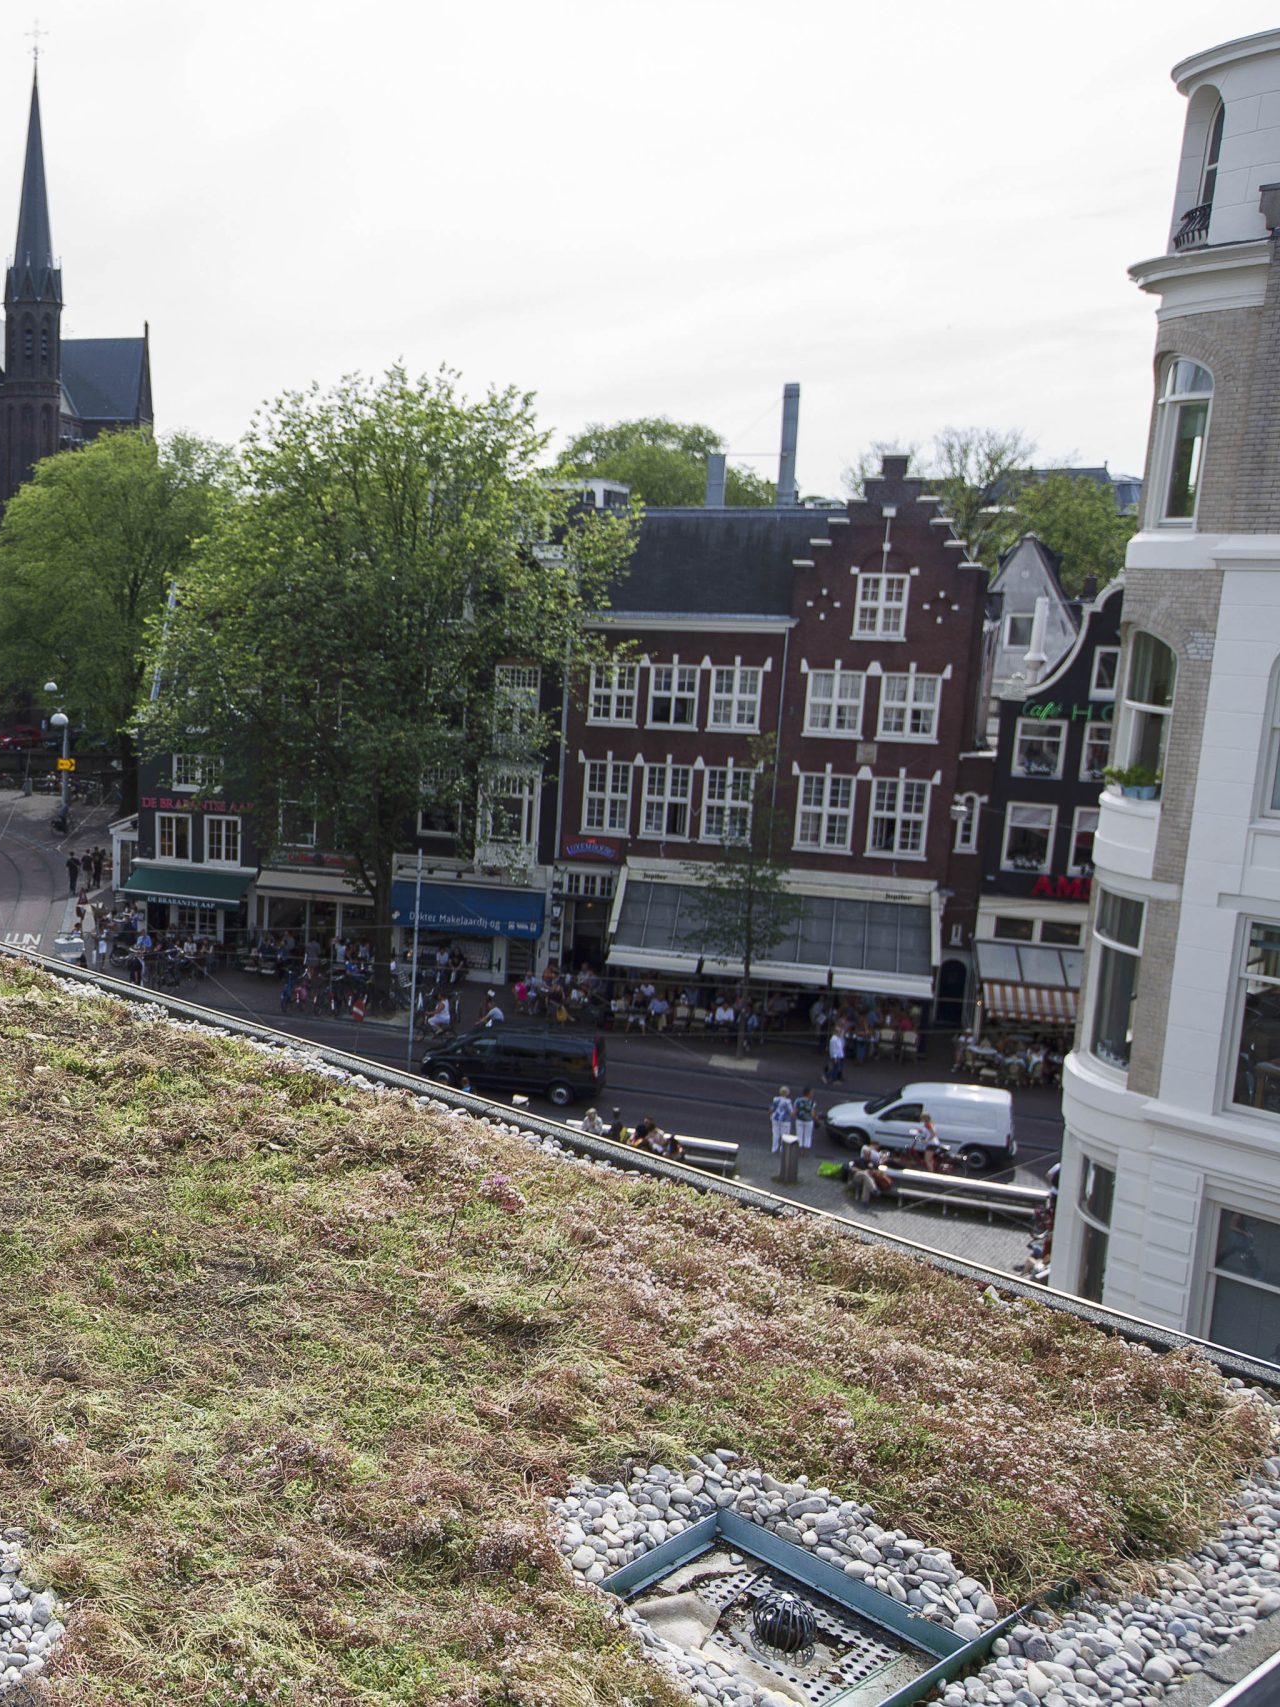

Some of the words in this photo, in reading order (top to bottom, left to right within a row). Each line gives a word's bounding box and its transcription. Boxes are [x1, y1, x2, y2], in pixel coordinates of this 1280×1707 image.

[1023, 699, 1064, 721] Café
[141, 797, 157, 808] DE
[158, 897, 198, 908] BRABANTSE
[439, 914, 487, 929] Makelaardij
